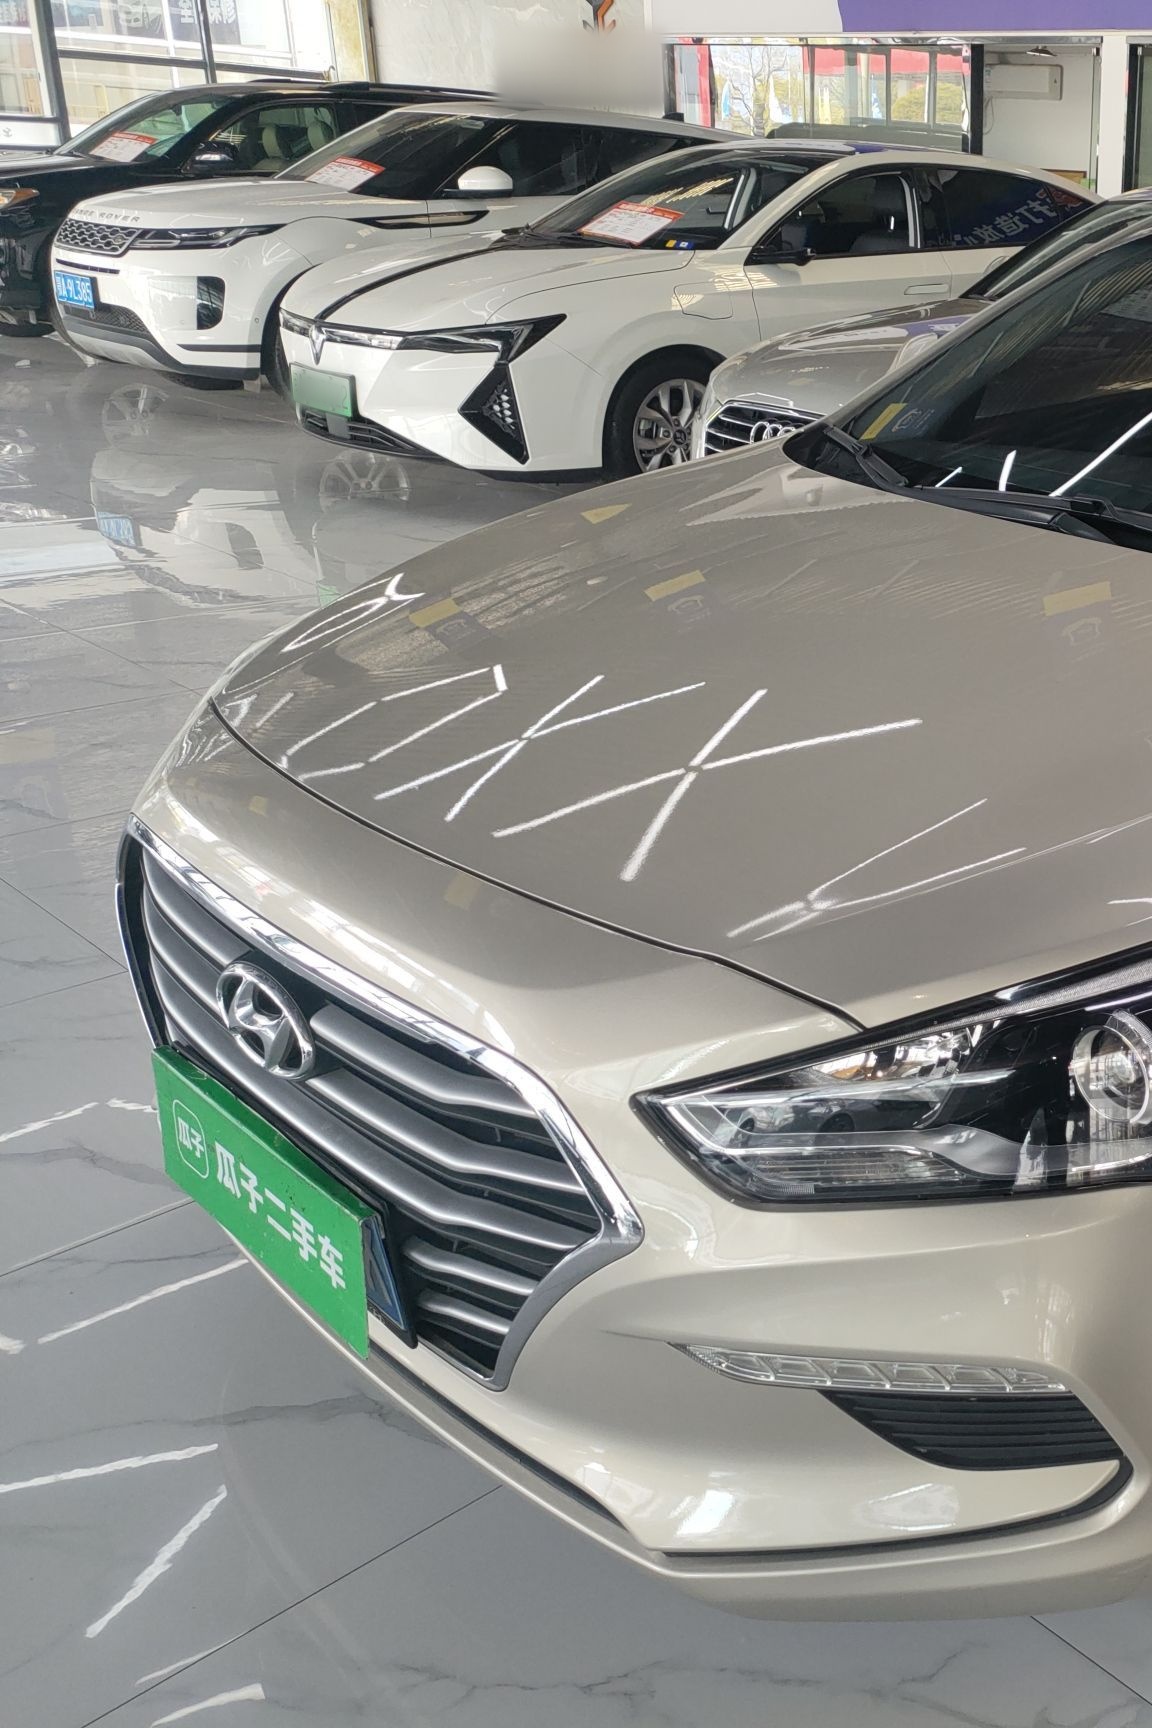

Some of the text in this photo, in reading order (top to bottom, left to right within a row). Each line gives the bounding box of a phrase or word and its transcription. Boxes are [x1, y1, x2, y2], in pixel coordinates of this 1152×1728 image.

[99, 211, 140, 223] ROVER
[178, 1116, 347, 1289] 瓜子 瓜子二手车
